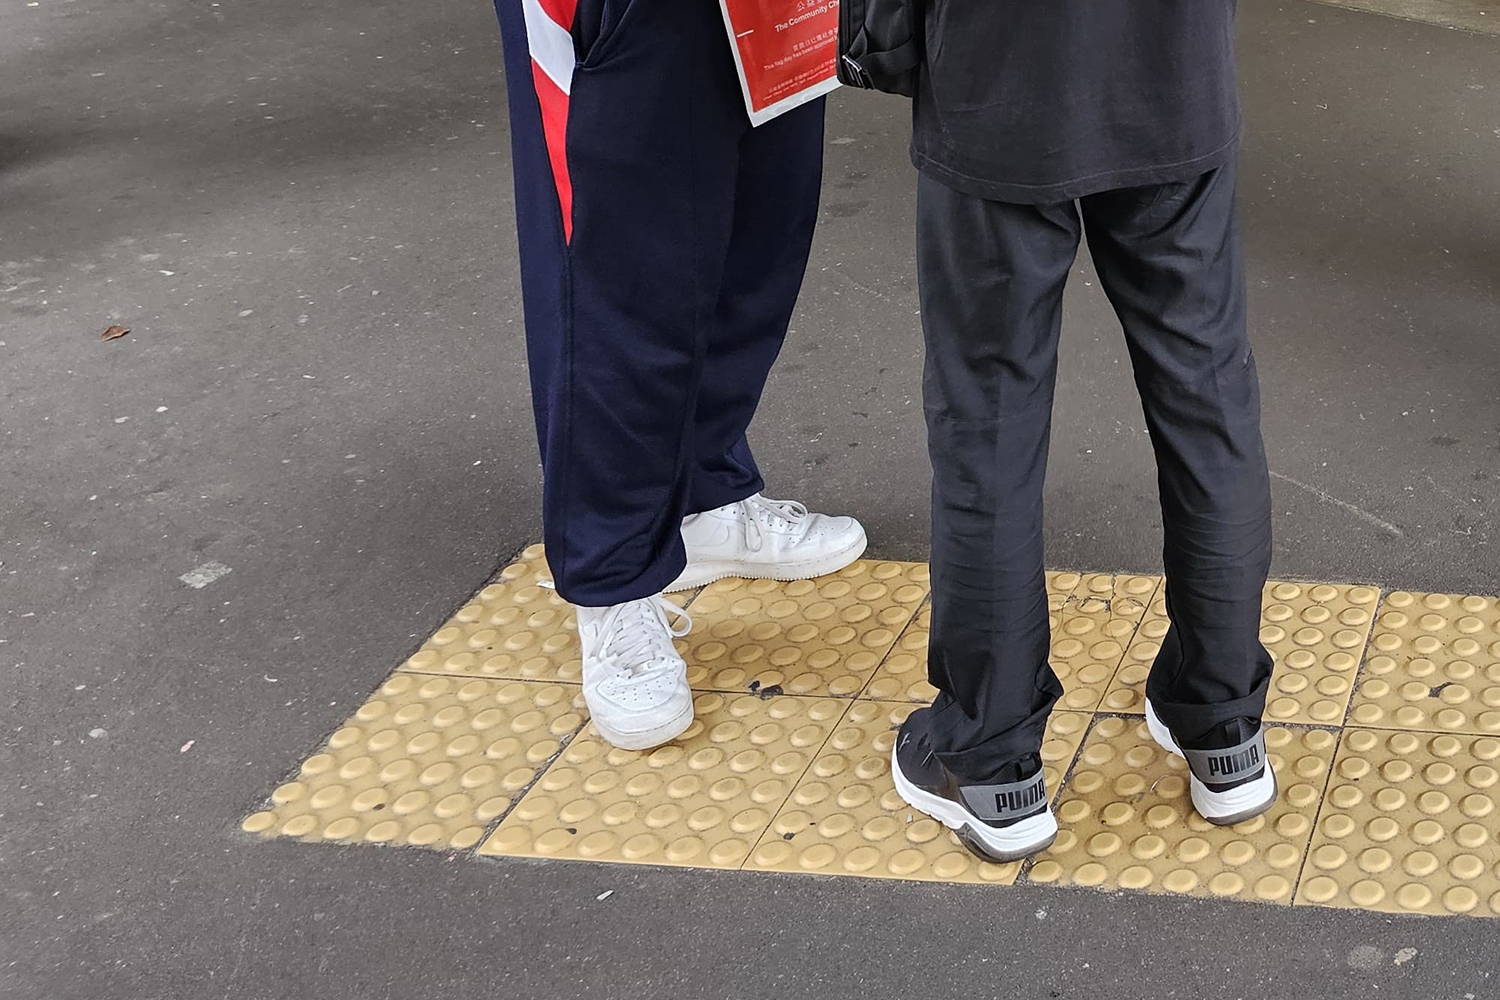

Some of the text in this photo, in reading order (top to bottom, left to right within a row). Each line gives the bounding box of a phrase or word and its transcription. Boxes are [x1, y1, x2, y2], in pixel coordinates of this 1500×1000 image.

[775, 22, 788, 33] The
[789, 5, 828, 26] Community
[1207, 744, 1260, 777] PUMA
[995, 778, 1046, 813] PUMA
